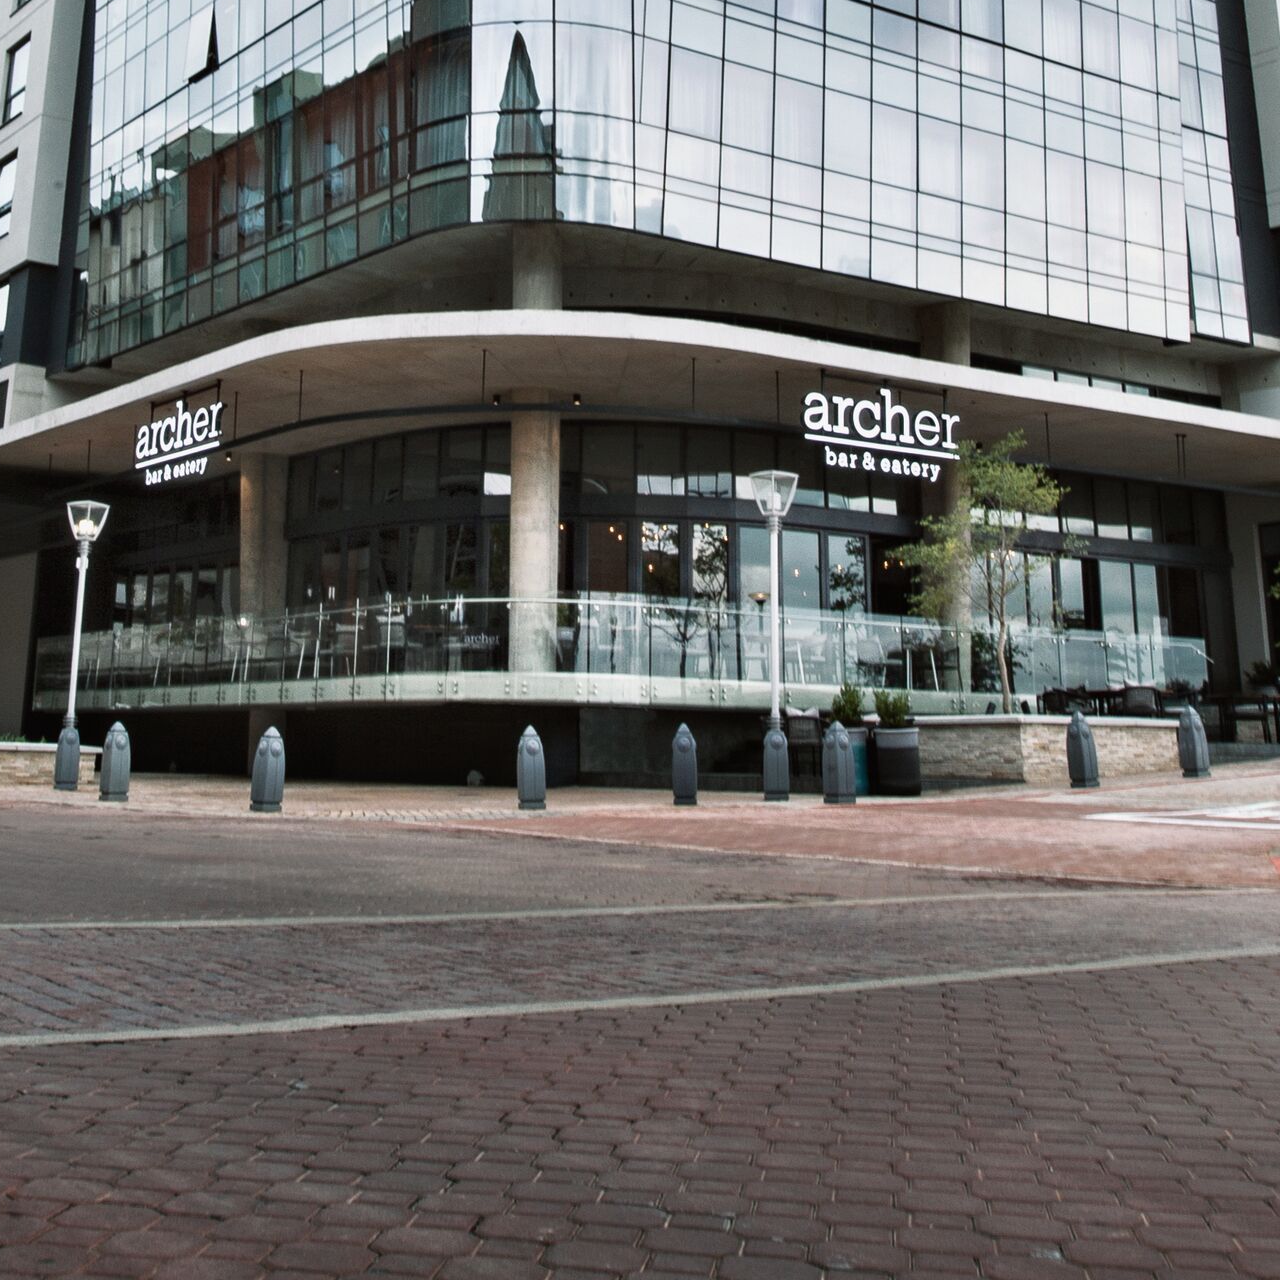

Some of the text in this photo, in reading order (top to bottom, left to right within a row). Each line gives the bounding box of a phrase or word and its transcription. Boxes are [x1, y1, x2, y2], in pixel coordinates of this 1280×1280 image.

[804, 388, 961, 449] archer
[145, 457, 208, 486] bar & eatery
[825, 445, 941, 483] bar & eatery
